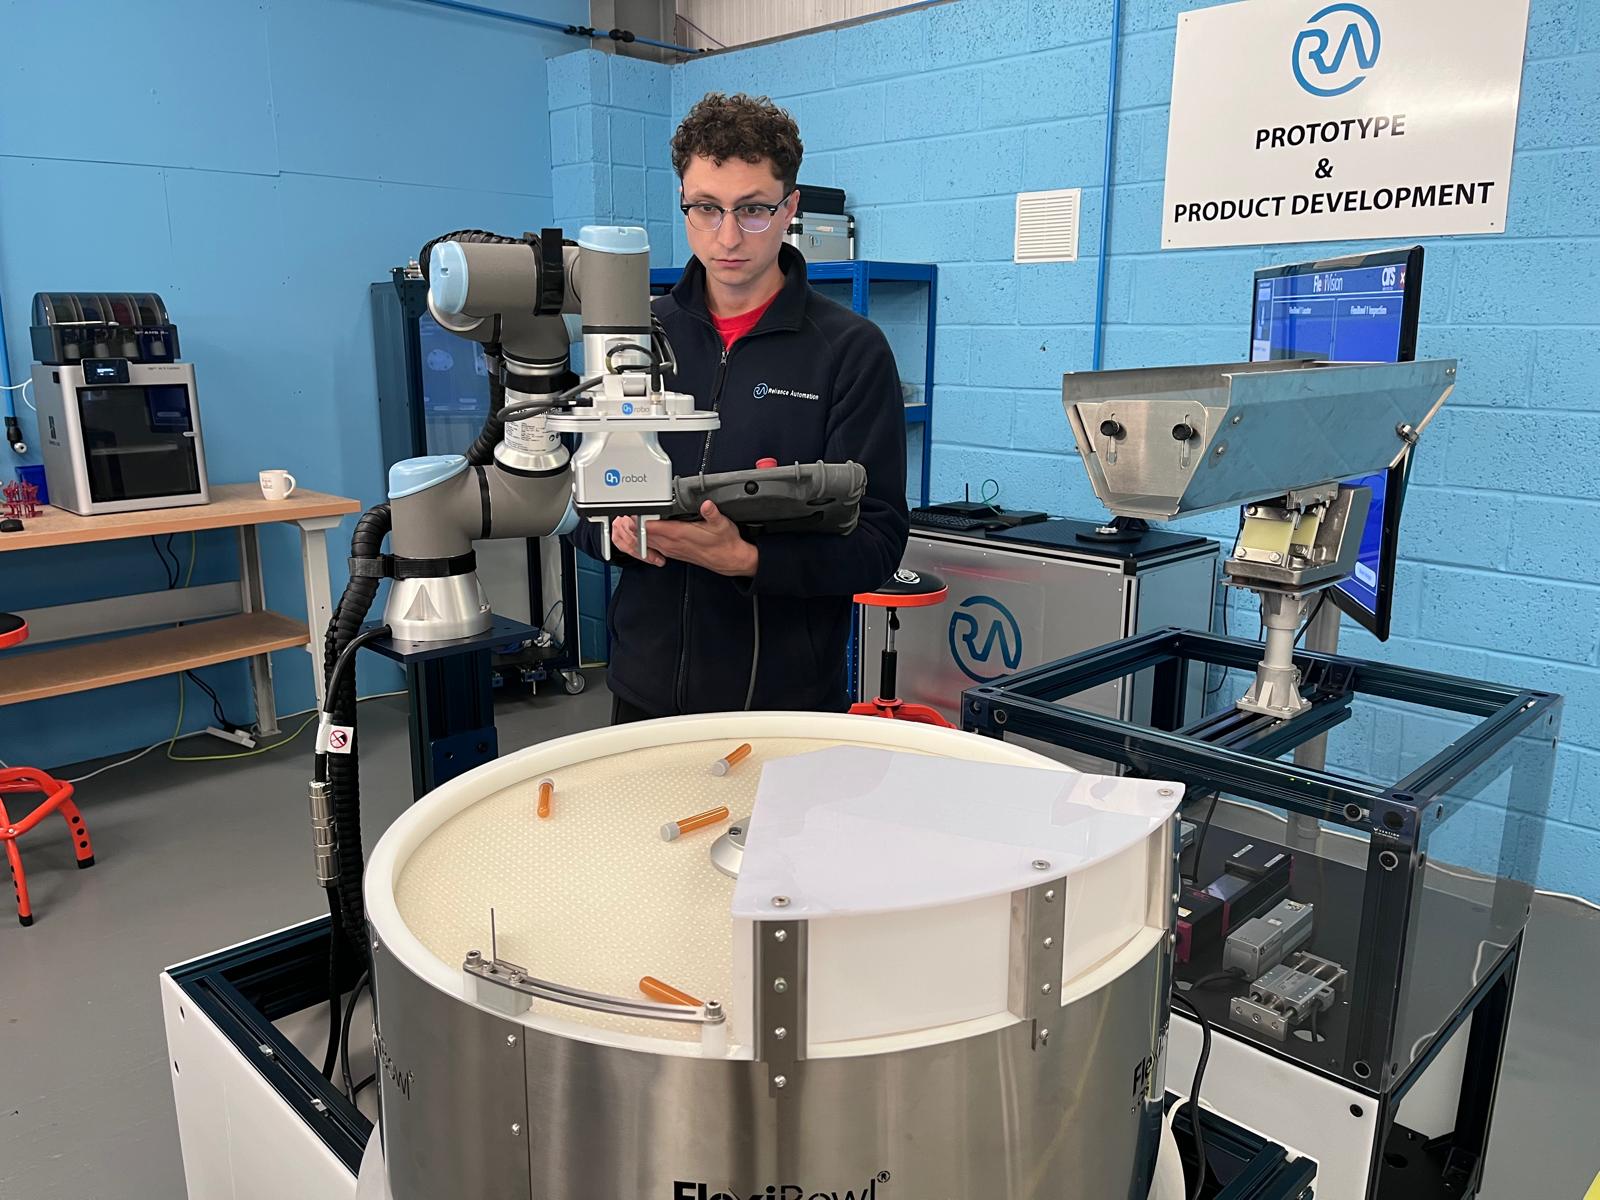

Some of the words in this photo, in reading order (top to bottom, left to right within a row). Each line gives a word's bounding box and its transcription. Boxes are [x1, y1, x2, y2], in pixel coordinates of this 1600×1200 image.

[1256, 114, 1406, 149] PROTOTYPE
[1315, 158, 1334, 179] &
[1174, 196, 1285, 223] PRODUCT
[1291, 182, 1495, 216] DEVELOPMENT
[768, 387, 789, 396] Reliance
[790, 390, 819, 400] Automation
[621, 473, 648, 483] robot
